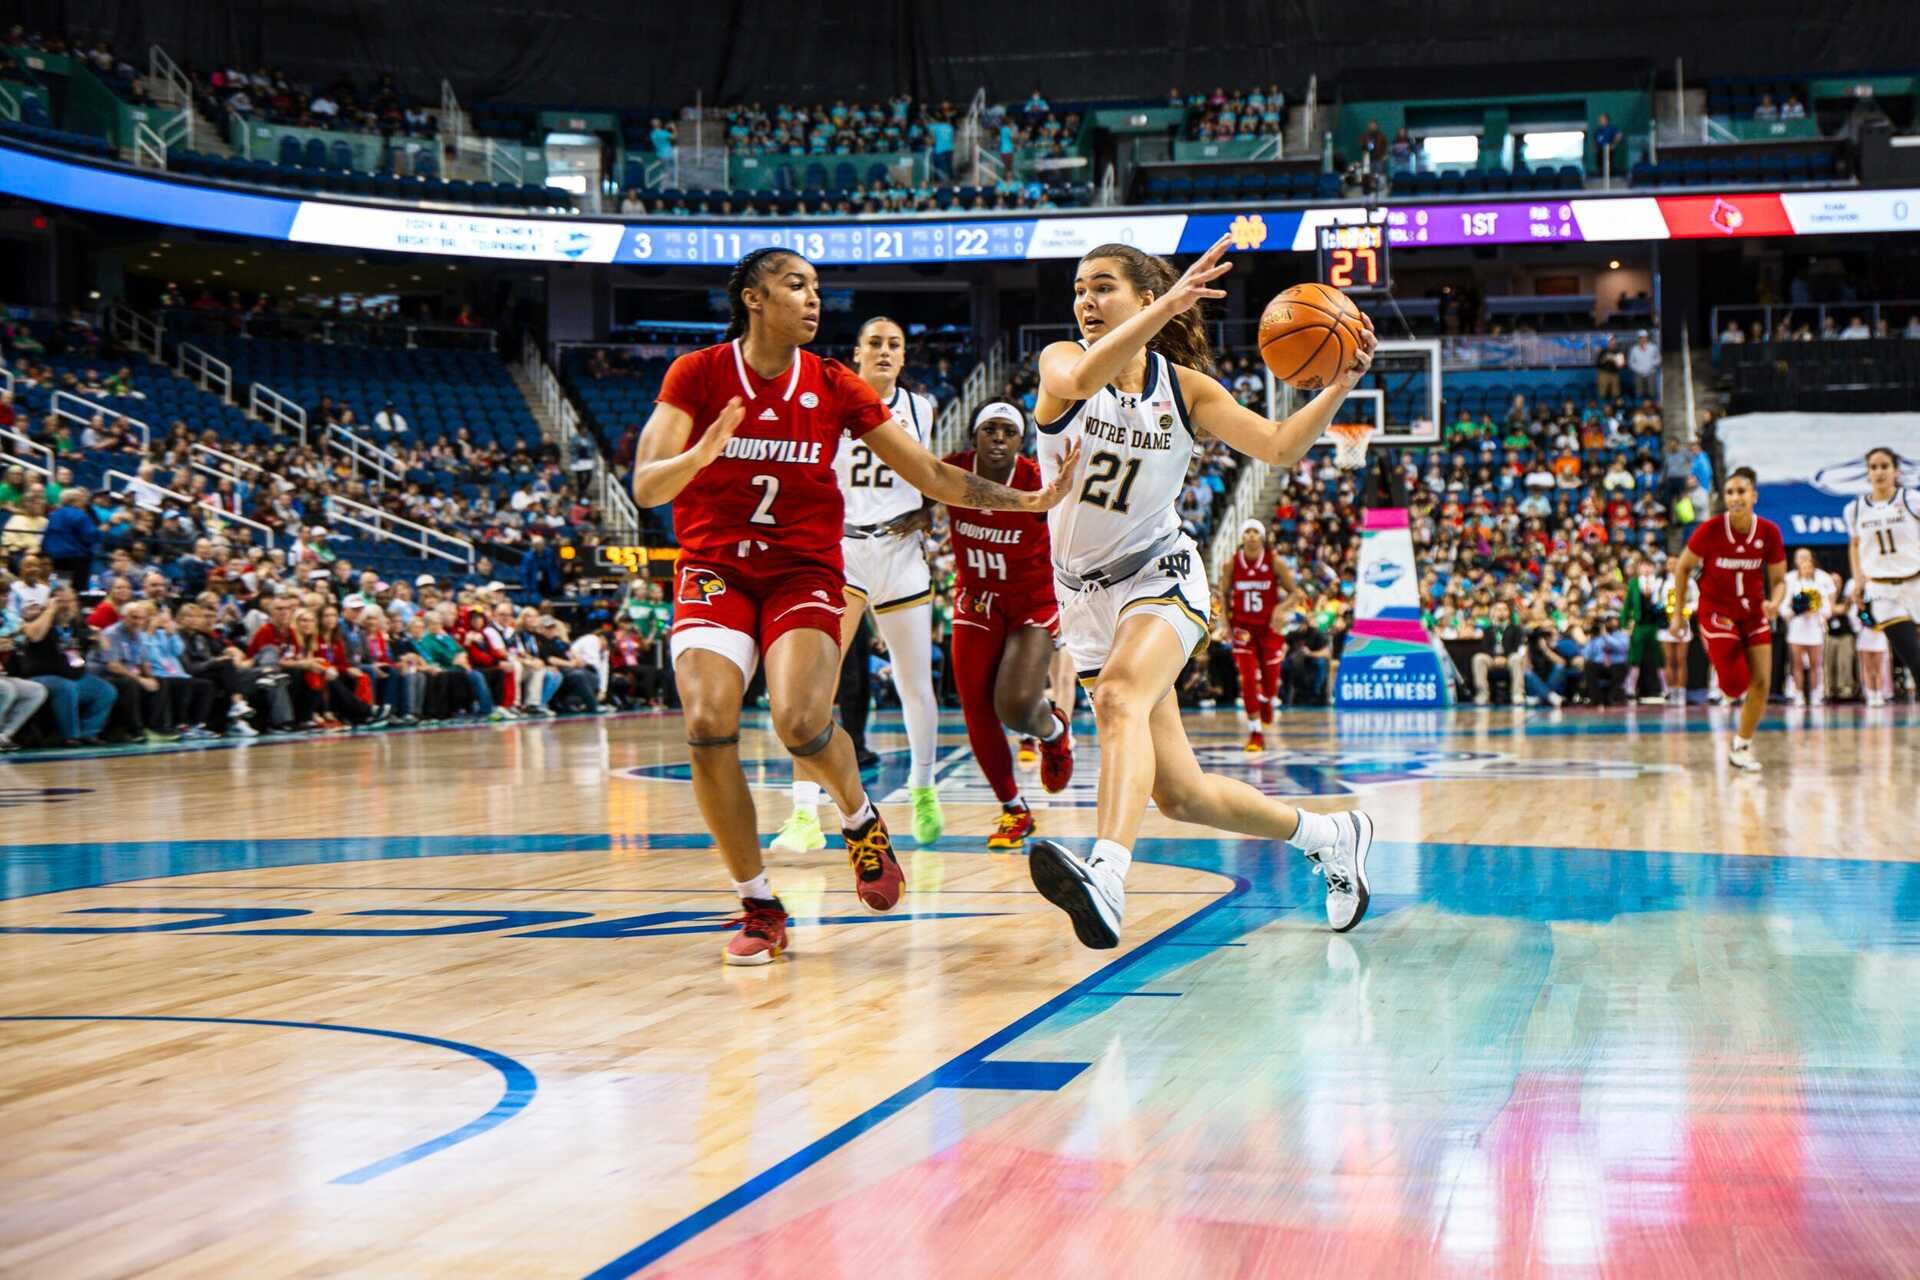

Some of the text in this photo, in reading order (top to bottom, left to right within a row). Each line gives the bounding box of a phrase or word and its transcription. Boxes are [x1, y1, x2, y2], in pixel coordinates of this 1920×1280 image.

[1461, 211, 1498, 236] 1ST
[632, 232, 653, 260] 3
[712, 233, 740, 259] 11
[793, 233, 825, 260] 13
[873, 231, 904, 258] 21
[954, 228, 990, 256] 22
[1330, 248, 1378, 288] 27
[1085, 416, 1172, 450] NOTRE DAME
[719, 436, 823, 464] OUISVILLE
[1079, 450, 1143, 514] 21
[750, 474, 781, 525] 2
[955, 519, 1023, 545] LOUISVILLE
[1875, 528, 1898, 555] 11
[967, 548, 1008, 581] 44
[1735, 571, 1745, 597] 1
[1243, 591, 1264, 613] 15
[1370, 655, 1407, 669] ACC
[1341, 682, 1437, 701] GREATNESS
